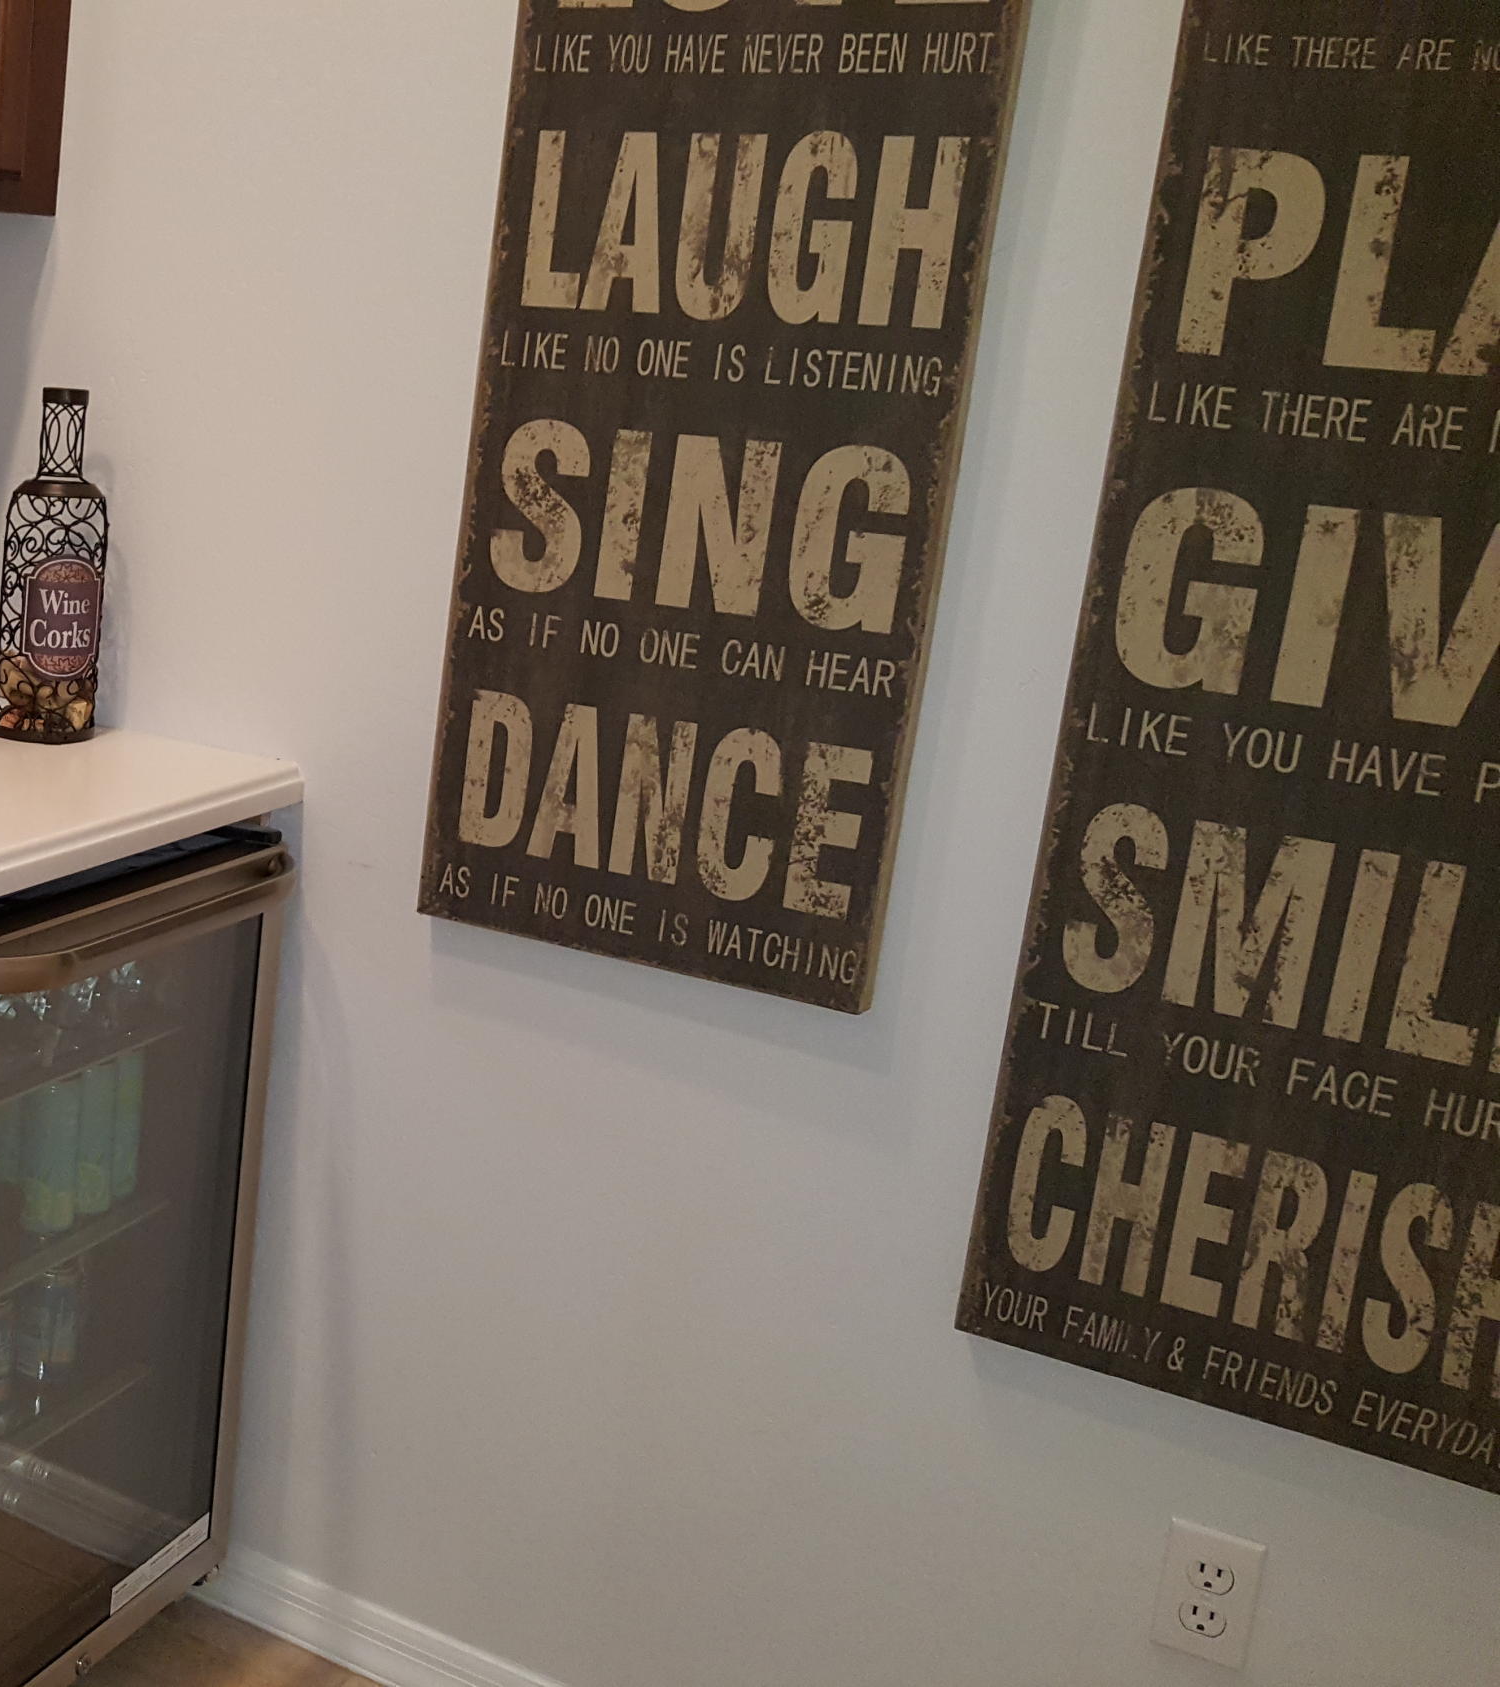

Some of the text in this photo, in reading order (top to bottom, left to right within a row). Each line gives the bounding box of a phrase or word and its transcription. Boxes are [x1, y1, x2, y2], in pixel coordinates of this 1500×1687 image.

[534, 31, 995, 74] LIKE YOU HAVE NEVER BEEN HURT
[1203, 32, 1272, 67] LIKE
[1292, 36, 1377, 70] THERE
[1396, 39, 1455, 71] ARE
[520, 129, 972, 329] LAUGH
[501, 333, 943, 397] LIKE NO ONE IS LISTENING
[1147, 380, 1237, 430] LIKE
[1261, 389, 1372, 443] THERE
[1391, 402, 1467, 452] ARE
[490, 418, 911, 634] SING
[29, 618, 91, 649] Corks
[39, 588, 90, 615] Wine
[468, 605, 896, 698] AS IF NO ONE CAN HEAR
[1086, 702, 1193, 757] LIKE
[1223, 722, 1302, 774] YOU
[1327, 739, 1447, 797] HAVE
[458, 689, 873, 921] DANCE
[438, 863, 860, 987] AS IF NO ONE IS WATCHING
[1062, 802, 1500, 1075] SMIL
[1037, 1001, 1128, 1058] TILL
[1162, 1031, 1261, 1087] YOUR
[1286, 1058, 1399, 1119] FACE
[982, 1281, 1048, 1333] YOUR
[1166, 1336, 1185, 1373] &
[1202, 1345, 1338, 1416] FRIENDS
[1351, 1389, 1500, 1468] EVERYDA
